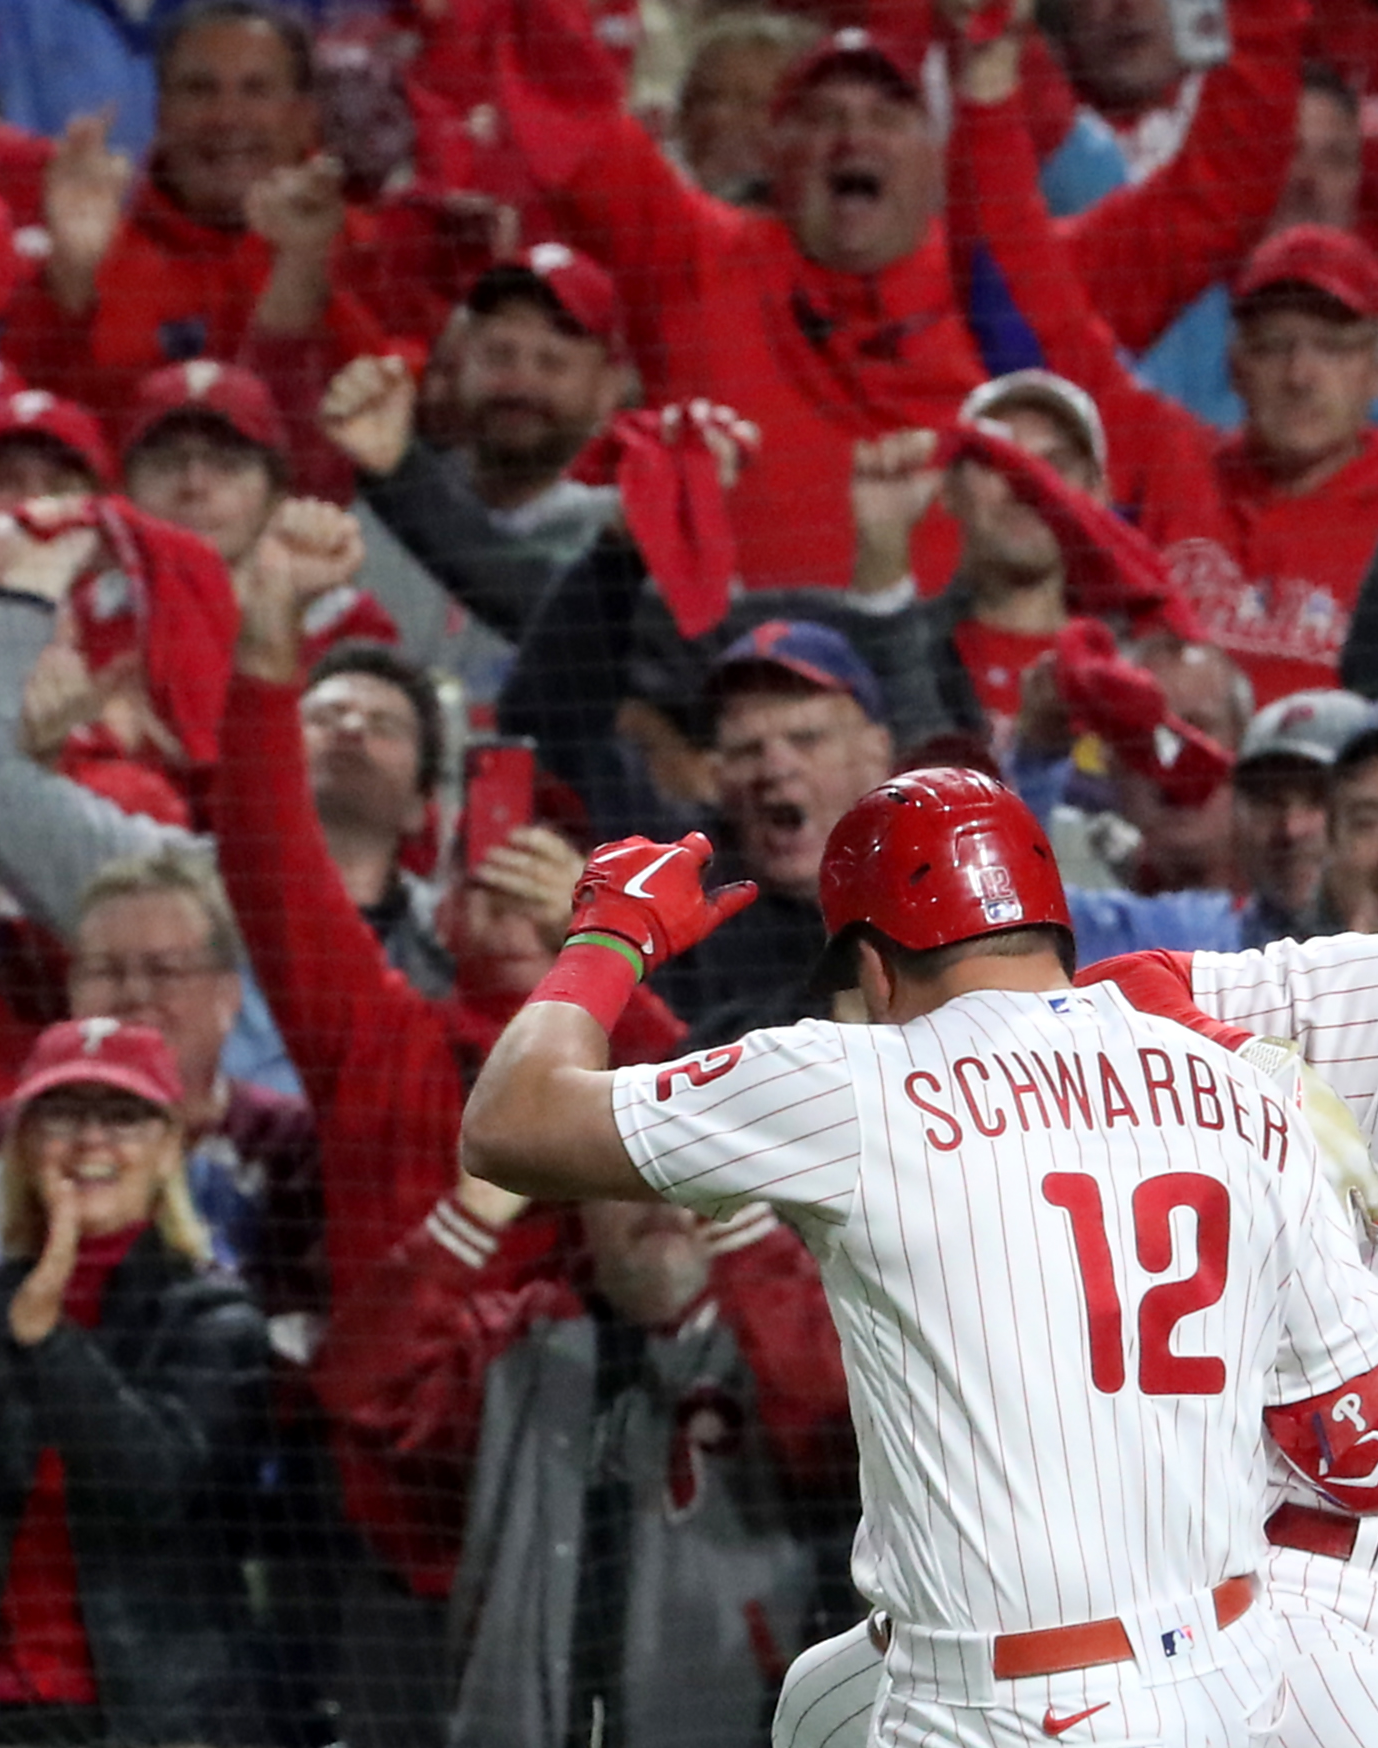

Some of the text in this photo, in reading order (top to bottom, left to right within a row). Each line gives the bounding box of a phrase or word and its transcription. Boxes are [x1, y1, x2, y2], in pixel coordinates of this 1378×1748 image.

[905, 1047, 1290, 1173] SCHWARBER
[1040, 1171, 1230, 1396] 12
[1332, 1392, 1366, 1432] P
